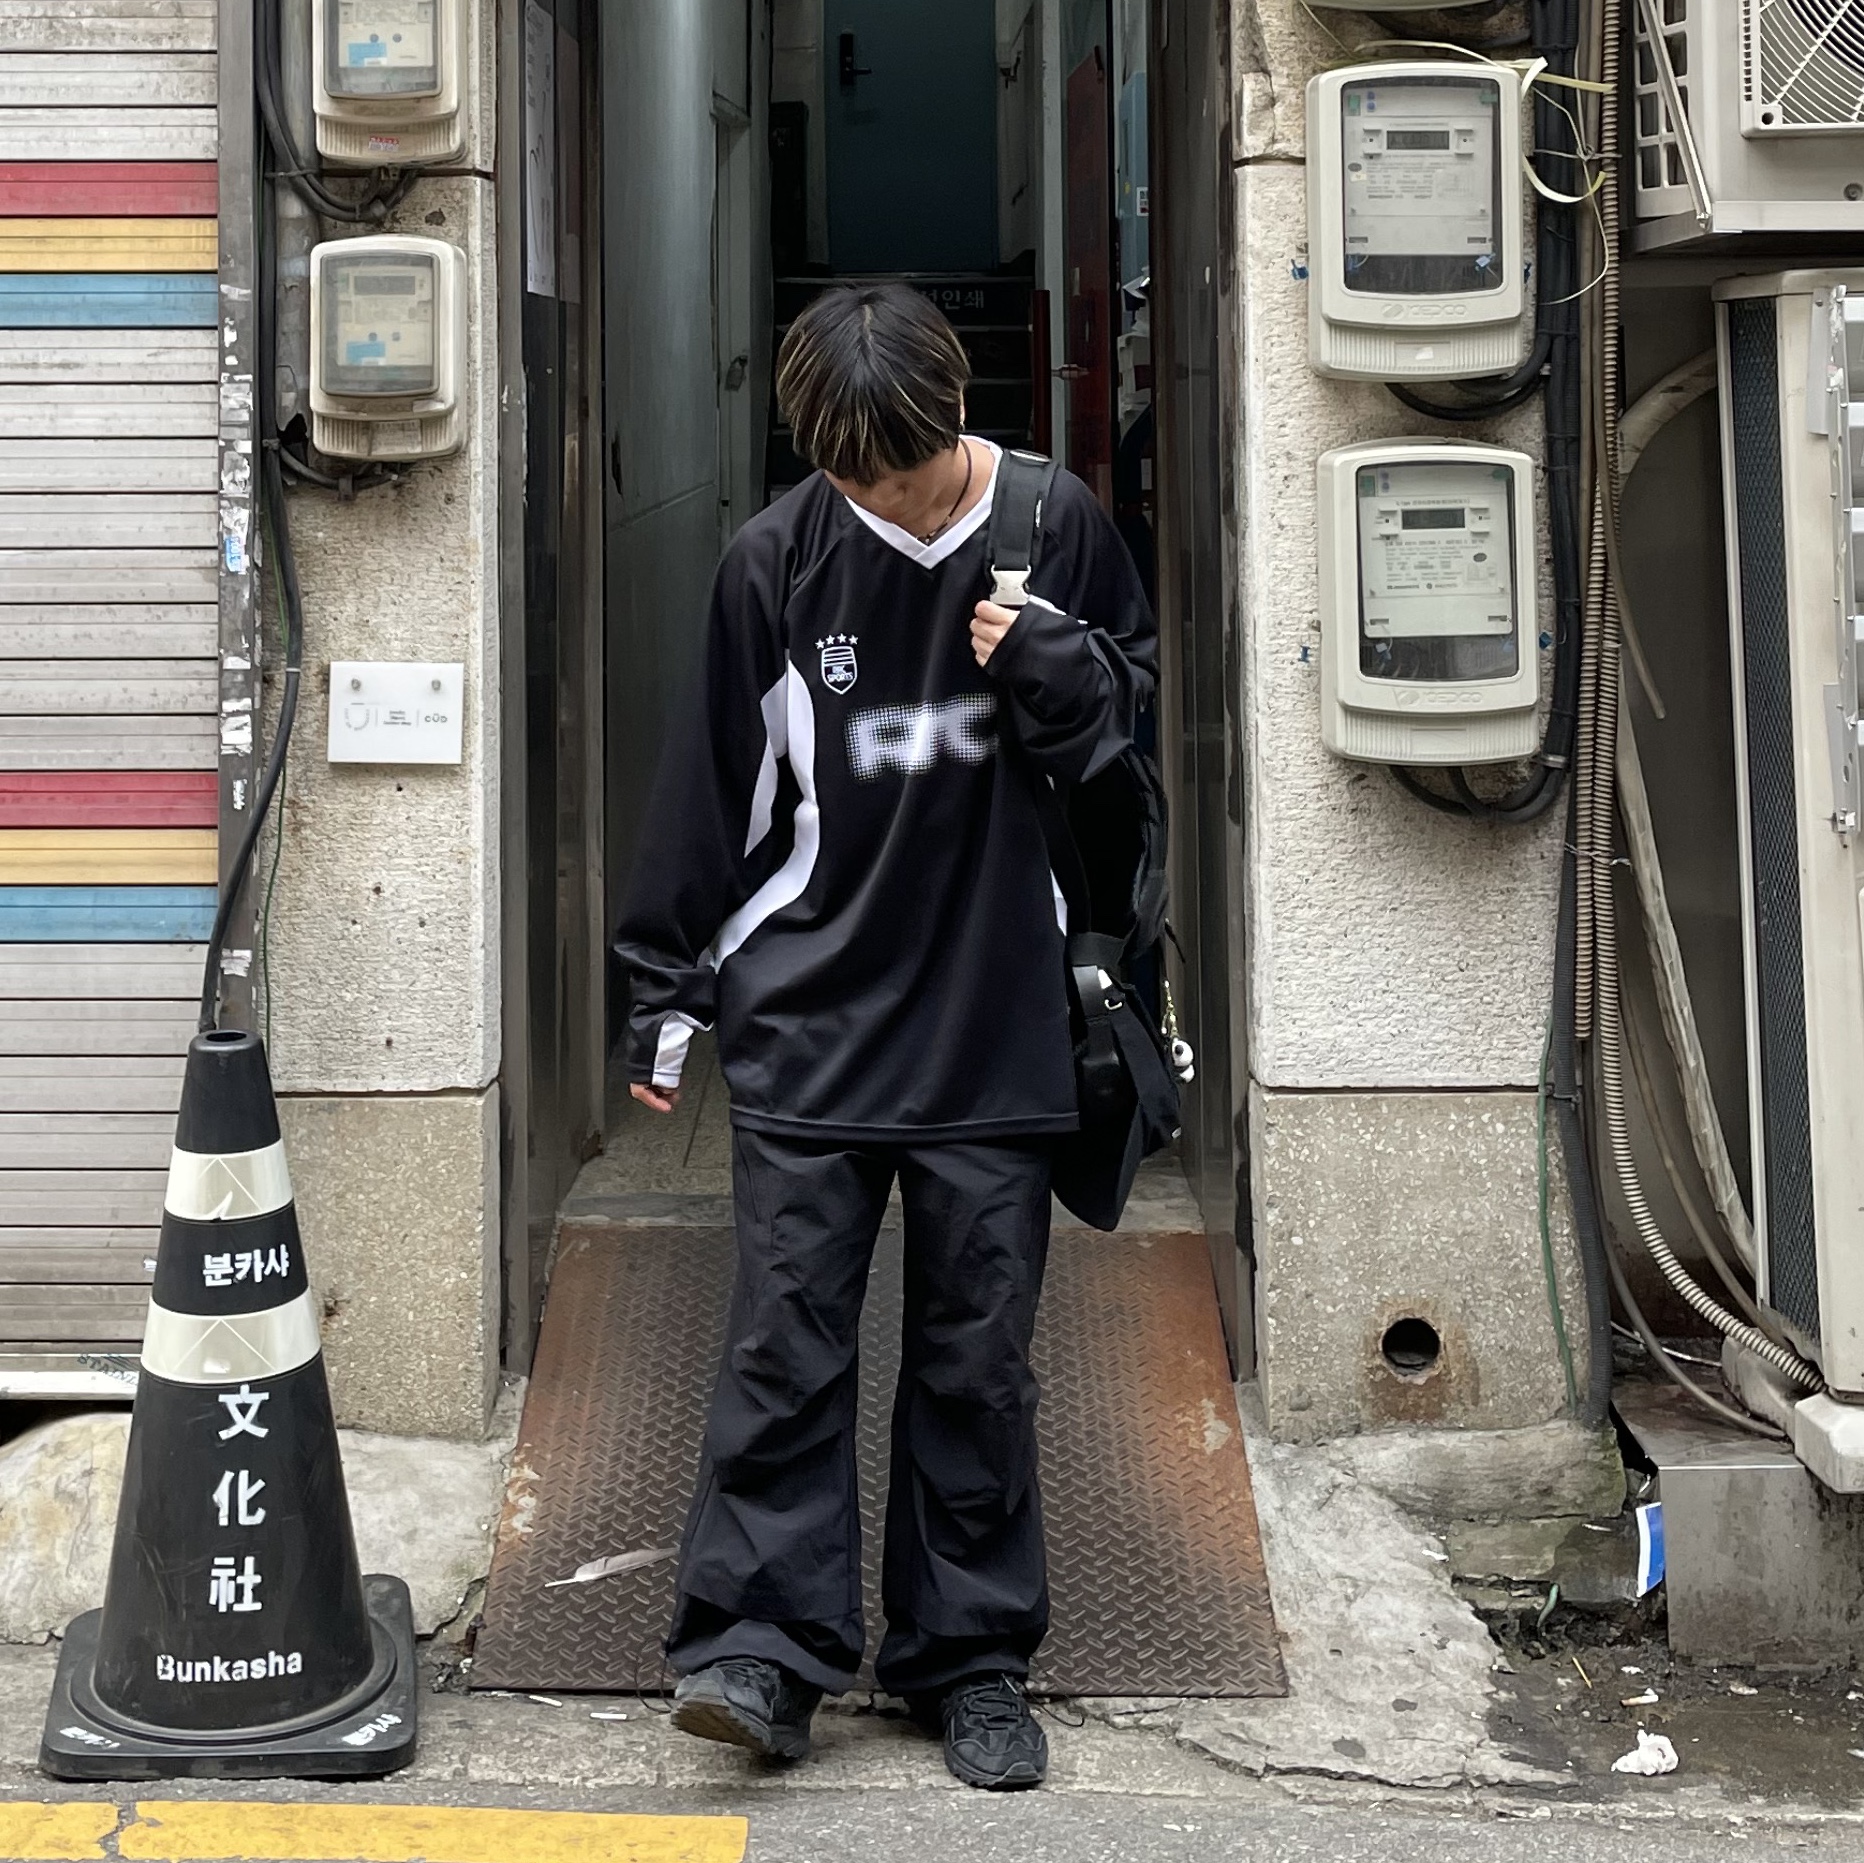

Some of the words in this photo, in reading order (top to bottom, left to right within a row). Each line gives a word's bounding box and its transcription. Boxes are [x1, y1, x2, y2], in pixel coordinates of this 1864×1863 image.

[202, 1243, 290, 1287] 분카샤
[208, 1384, 270, 1613] 文化社
[156, 1650, 302, 1682] Bunkasha
